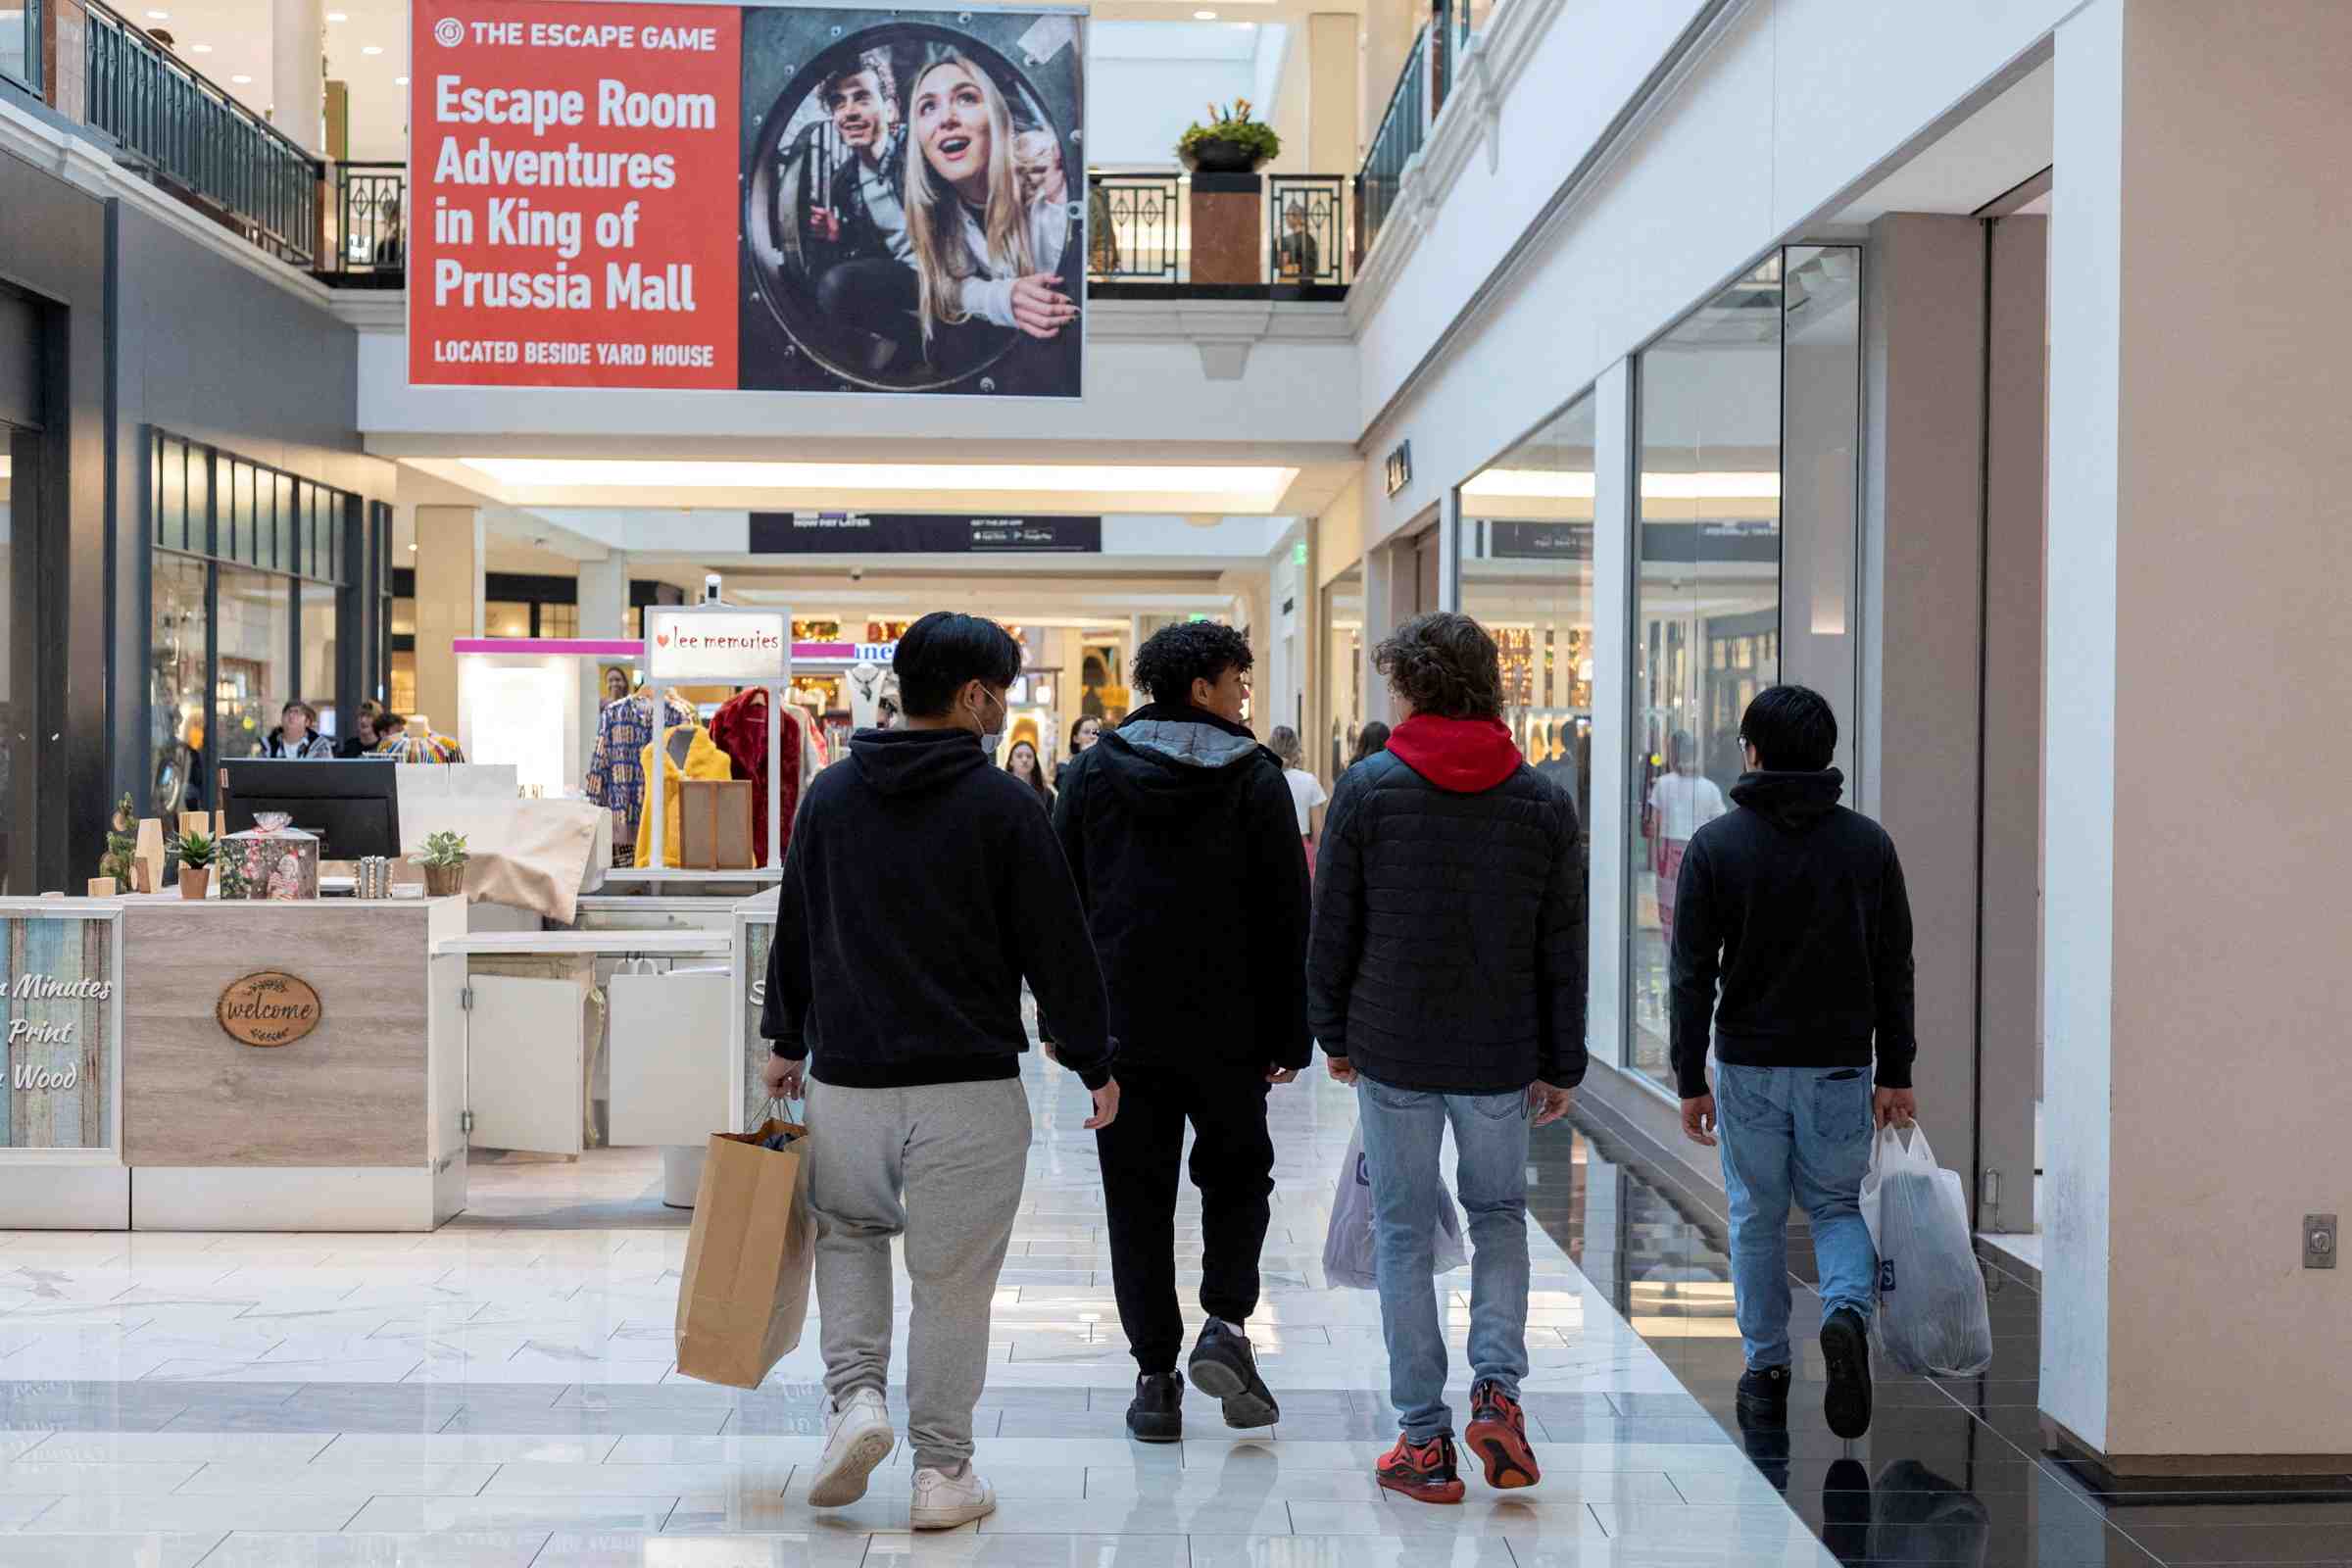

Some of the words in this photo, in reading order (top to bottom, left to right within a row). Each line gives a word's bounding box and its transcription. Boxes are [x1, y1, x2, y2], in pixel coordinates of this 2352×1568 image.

[470, 22, 523, 46] THE
[530, 24, 635, 48] ESCAPE
[640, 26, 716, 51] GAME
[436, 74, 584, 136] Escape
[598, 78, 715, 129] Room
[433, 135, 676, 189] Adventures
[435, 196, 473, 245] in
[488, 197, 581, 259] King
[595, 200, 640, 248] of
[435, 258, 592, 310] Prussia
[606, 262, 696, 312] Mall
[434, 340, 518, 364] LOCATED
[524, 342, 591, 366] BESIDE
[596, 343, 647, 367] YARD
[652, 344, 714, 368] HOUSE
[673, 625, 698, 648] lee
[704, 629, 779, 651] memories
[13, 973, 113, 1000] Minutes
[226, 992, 314, 1020] welcome
[8, 1019, 75, 1044] Print
[14, 1061, 78, 1090] Wood
